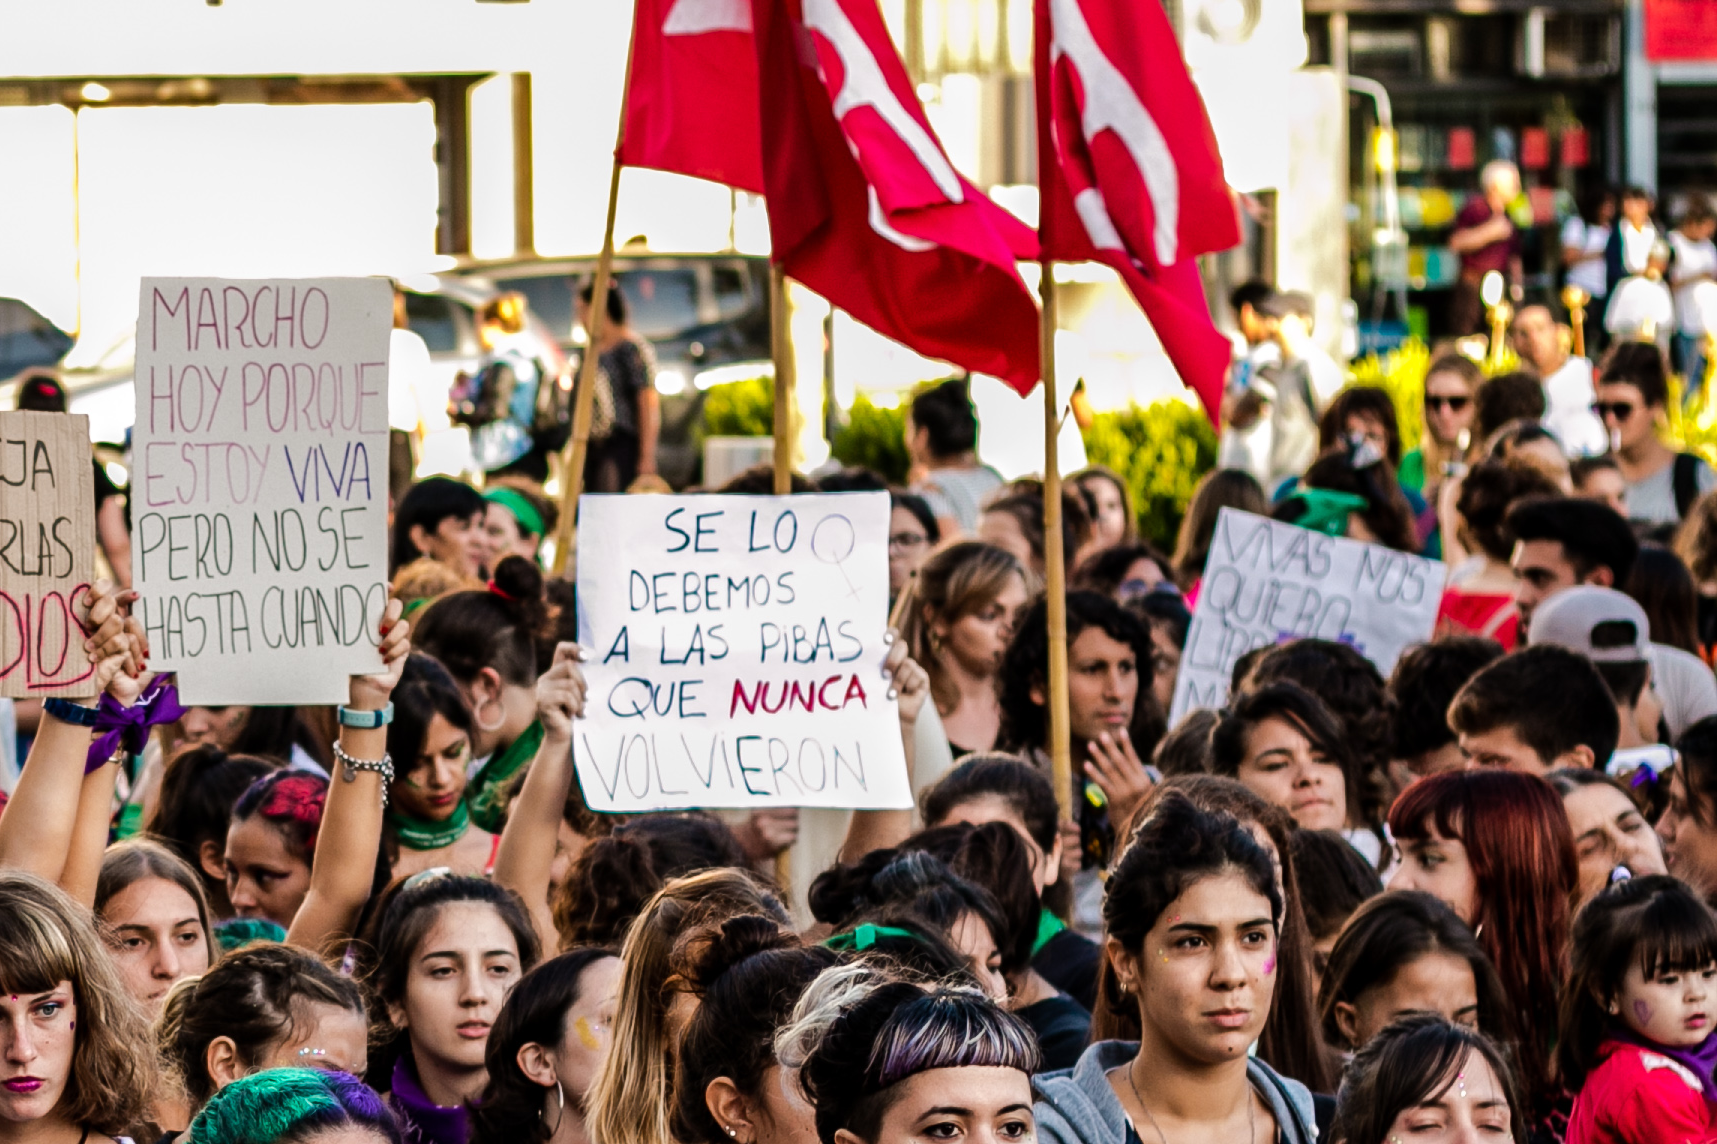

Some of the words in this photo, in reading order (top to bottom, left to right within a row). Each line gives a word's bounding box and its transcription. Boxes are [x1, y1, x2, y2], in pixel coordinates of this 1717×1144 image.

[152, 286, 329, 351] MARCHO
[150, 365, 228, 434] HOY
[242, 362, 387, 437] PORQUE
[146, 441, 270, 507] ESTOY
[284, 441, 371, 503] VIVA
[139, 513, 233, 582] PERO
[253, 508, 307, 574] NO
[318, 506, 369, 571] SE
[664, 507, 724, 553] SE
[748, 510, 798, 553] LO
[1222, 514, 1332, 579] VIVAS
[1353, 546, 1432, 605] NOS
[143, 590, 251, 660] HASTA
[261, 582, 387, 649] CUANDO
[629, 569, 796, 614] DEBEMOS
[603, 625, 630, 664] A
[660, 623, 729, 665] LAS
[608, 677, 707, 720] QUE
[730, 673, 868, 719] NUNCA
